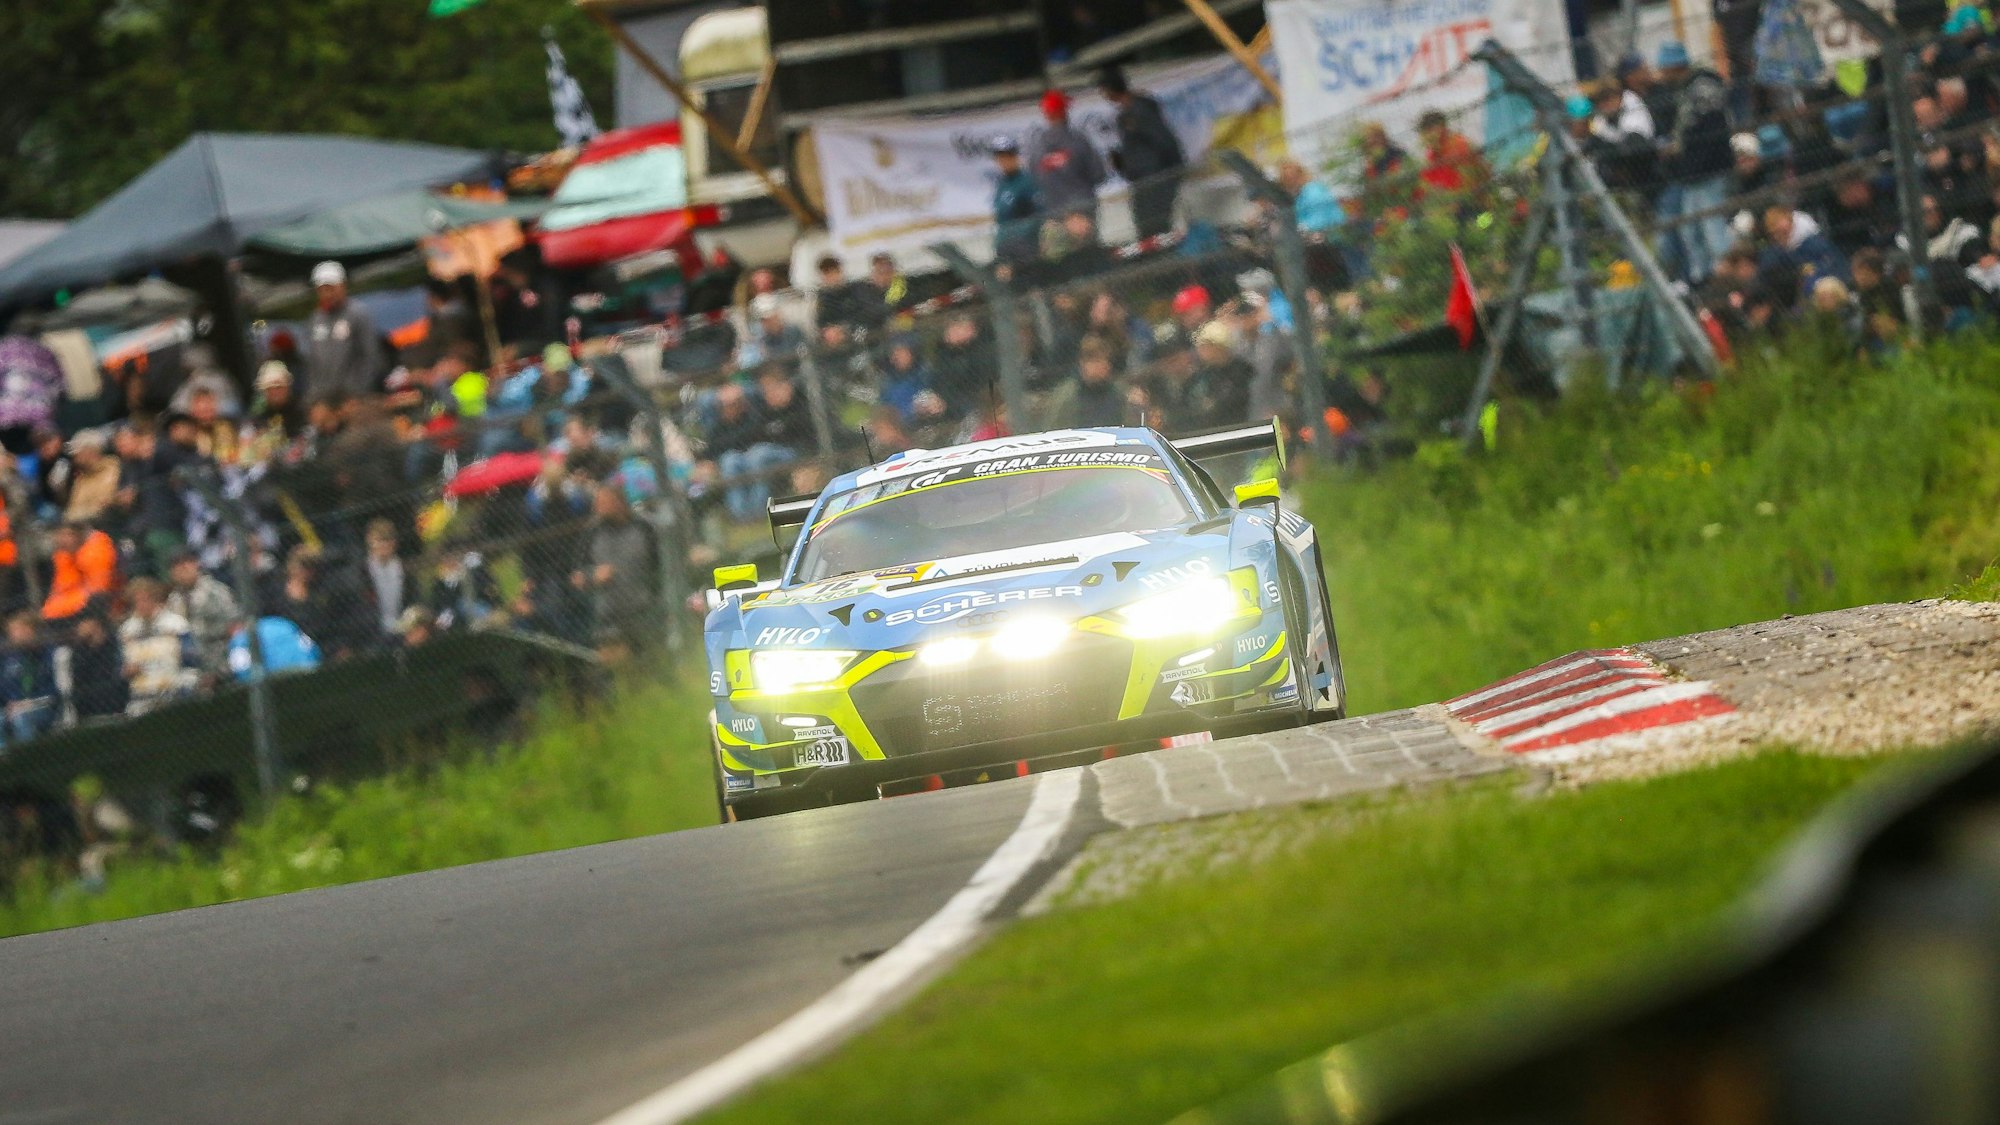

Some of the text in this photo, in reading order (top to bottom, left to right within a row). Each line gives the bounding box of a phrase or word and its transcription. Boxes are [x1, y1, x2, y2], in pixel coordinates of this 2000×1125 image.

[974, 455, 1040, 474] GRAN
[1047, 451, 1151, 468] TURISMO
[995, 468, 1029, 476] REAL
[1031, 462, 1077, 470] DRIVING
[1080, 461, 1147, 469] SIMULATOR
[816, 579, 860, 593] 16
[885, 585, 1083, 626] SCHERER
[755, 627, 822, 646] HYLO
[1237, 636, 1266, 653] HYLO
[1165, 667, 1203, 679] RAVENOL
[731, 718, 756, 732] HYLO
[797, 728, 832, 737] RAVENOL
[796, 743, 825, 765] H&R
